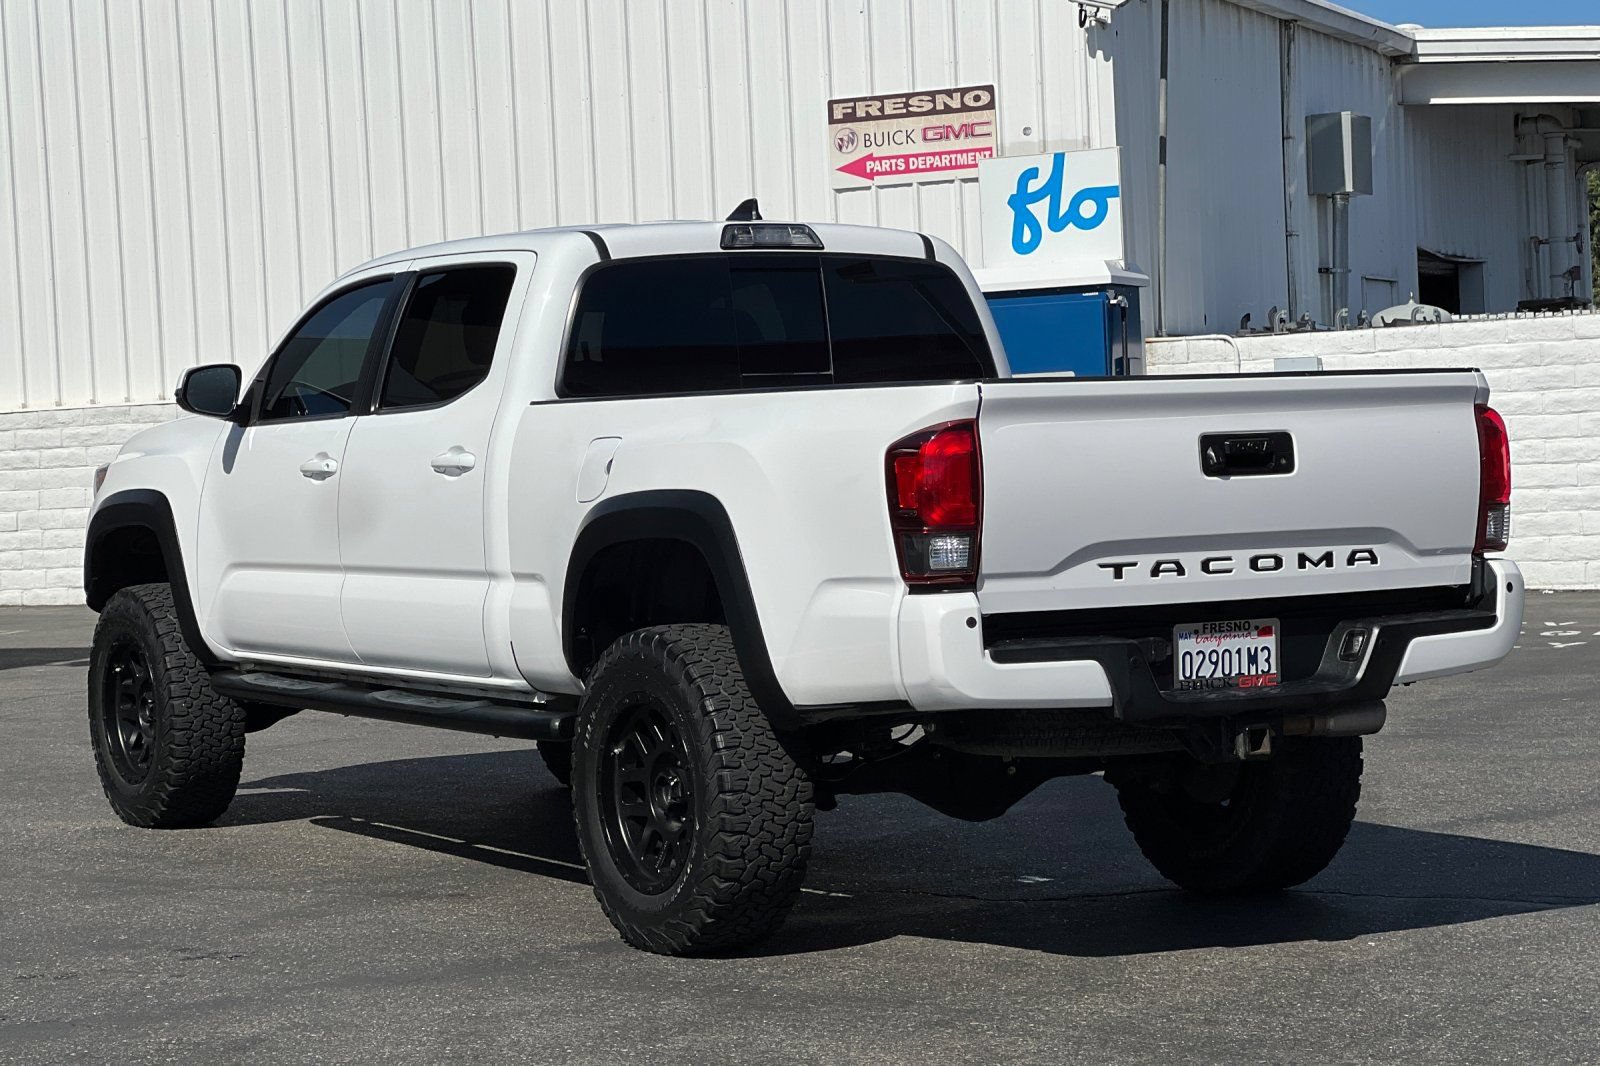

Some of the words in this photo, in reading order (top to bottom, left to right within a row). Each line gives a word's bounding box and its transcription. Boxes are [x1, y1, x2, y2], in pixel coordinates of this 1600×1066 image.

[832, 89, 992, 120] FRESNO
[863, 129, 916, 148] BUICK
[921, 120, 993, 143] GMC
[865, 157, 906, 173] PARTS
[908, 150, 992, 170] DEPARTMENT
[1007, 152, 1120, 256] flo
[1097, 547, 1379, 580] TACOMA
[1178, 632, 1192, 641] MAY
[1195, 631, 1257, 647] California
[1202, 620, 1251, 634] FRESNO
[1181, 645, 1272, 680] 02901M3
[1238, 674, 1278, 689] GMC
